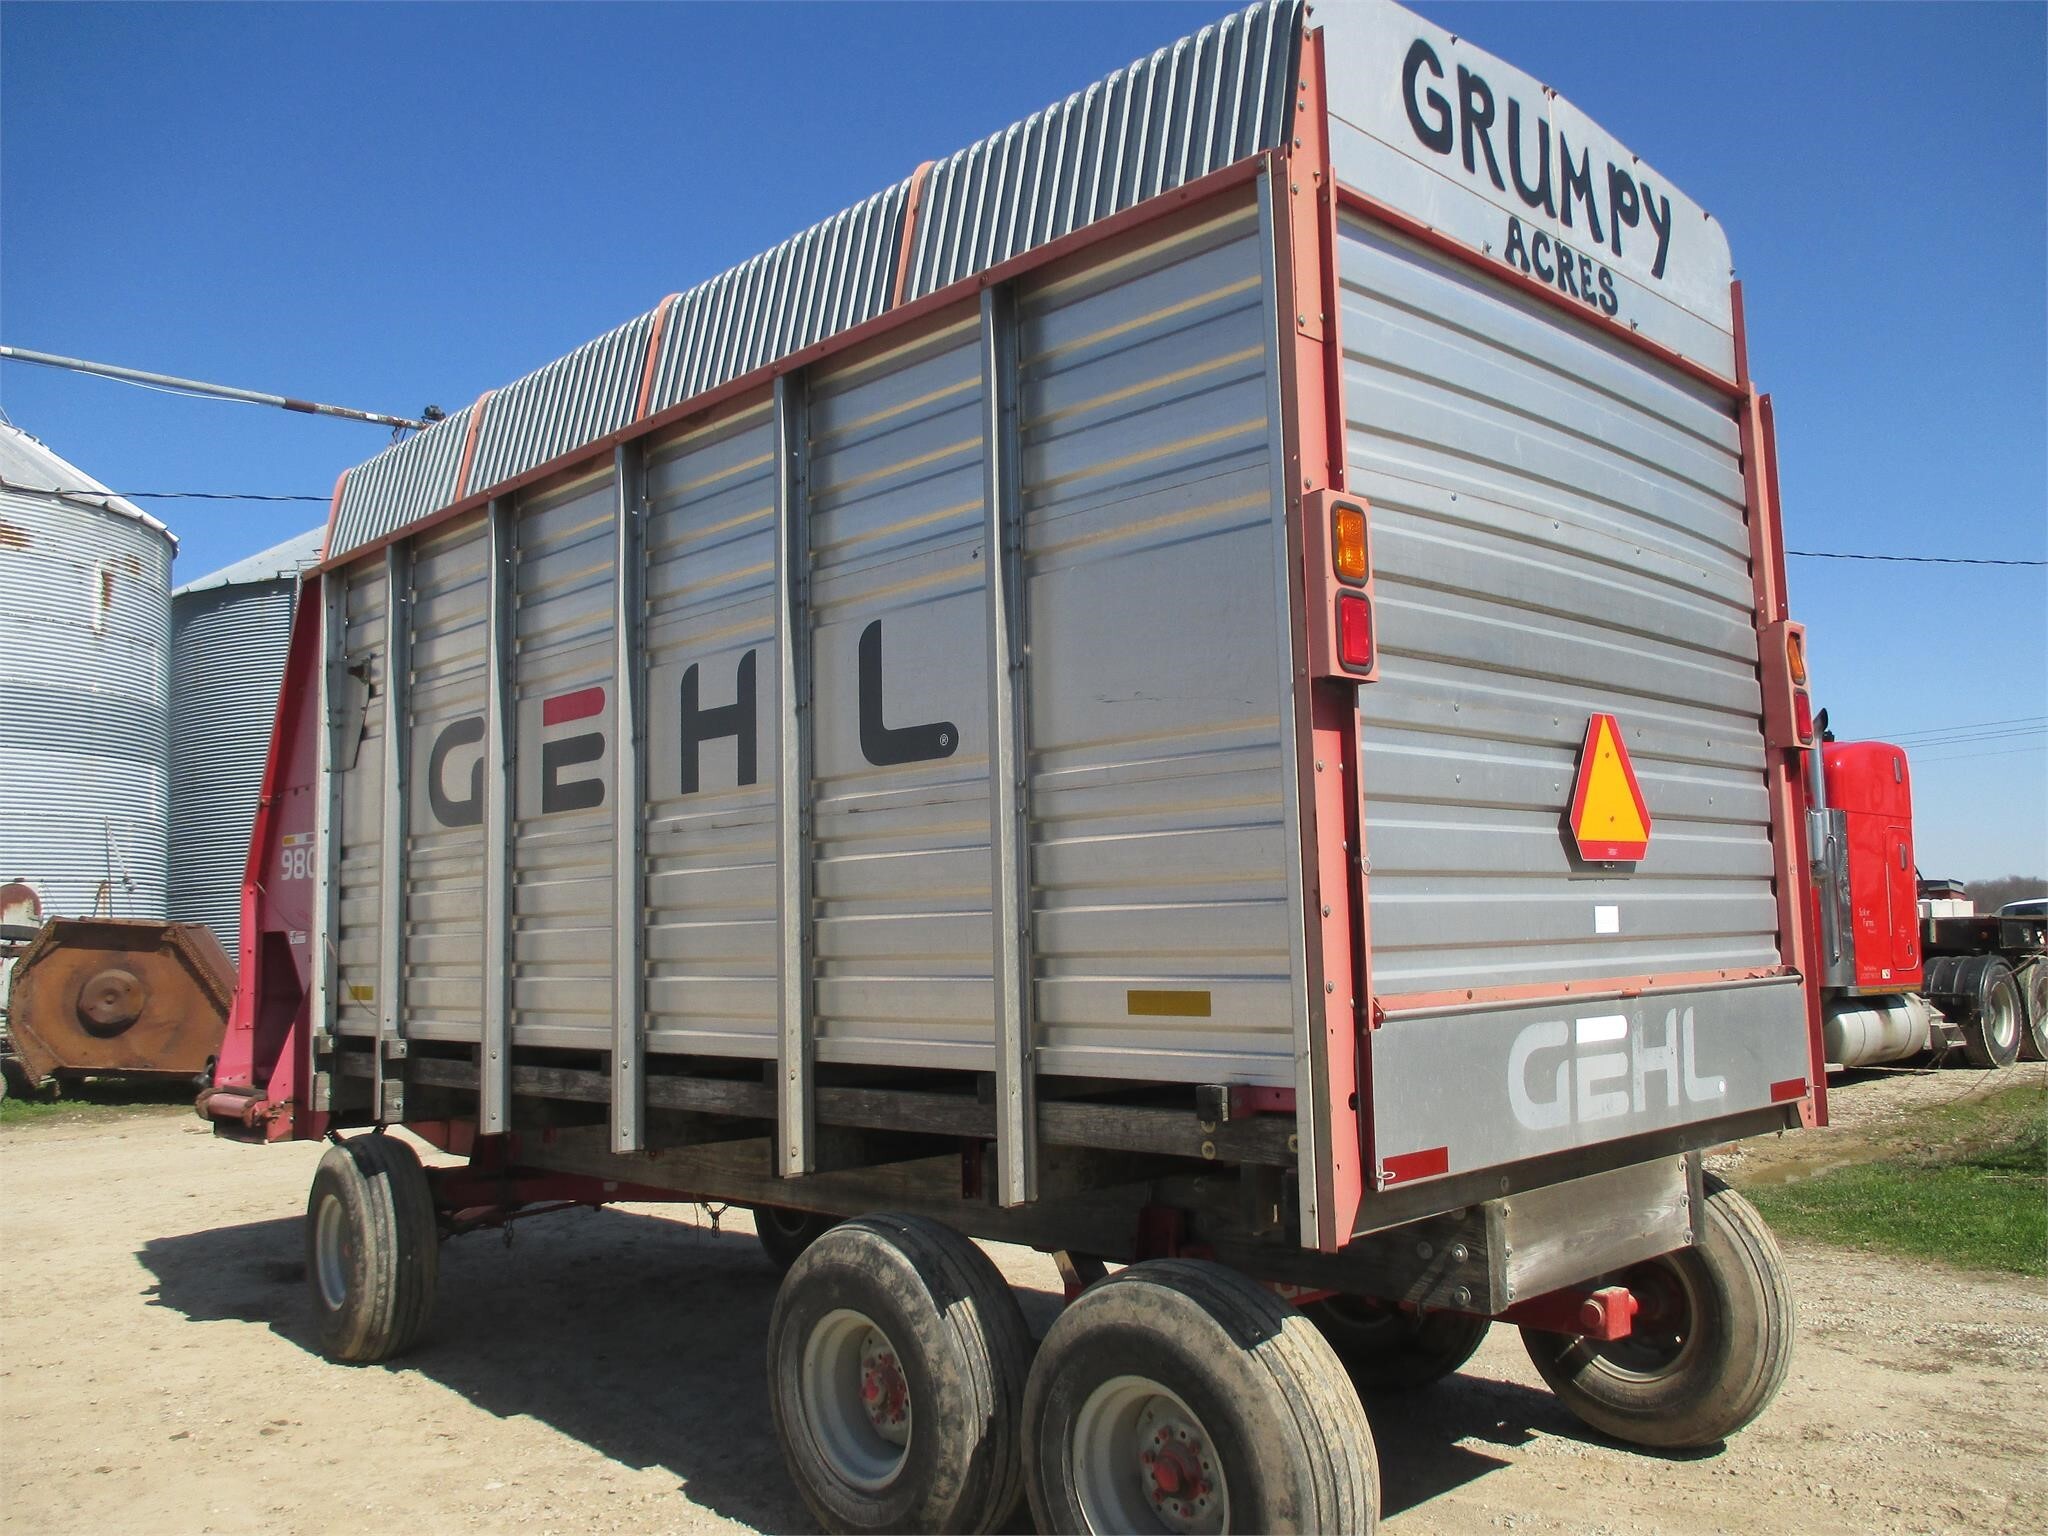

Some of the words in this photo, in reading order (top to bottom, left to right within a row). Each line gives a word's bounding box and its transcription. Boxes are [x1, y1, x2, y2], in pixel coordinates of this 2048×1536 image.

[1402, 38, 1671, 280] GRUMPY
[1505, 216, 1618, 316] ACRES
[429, 619, 959, 828] GEHL
[1508, 1006, 1726, 1131] GEHL
